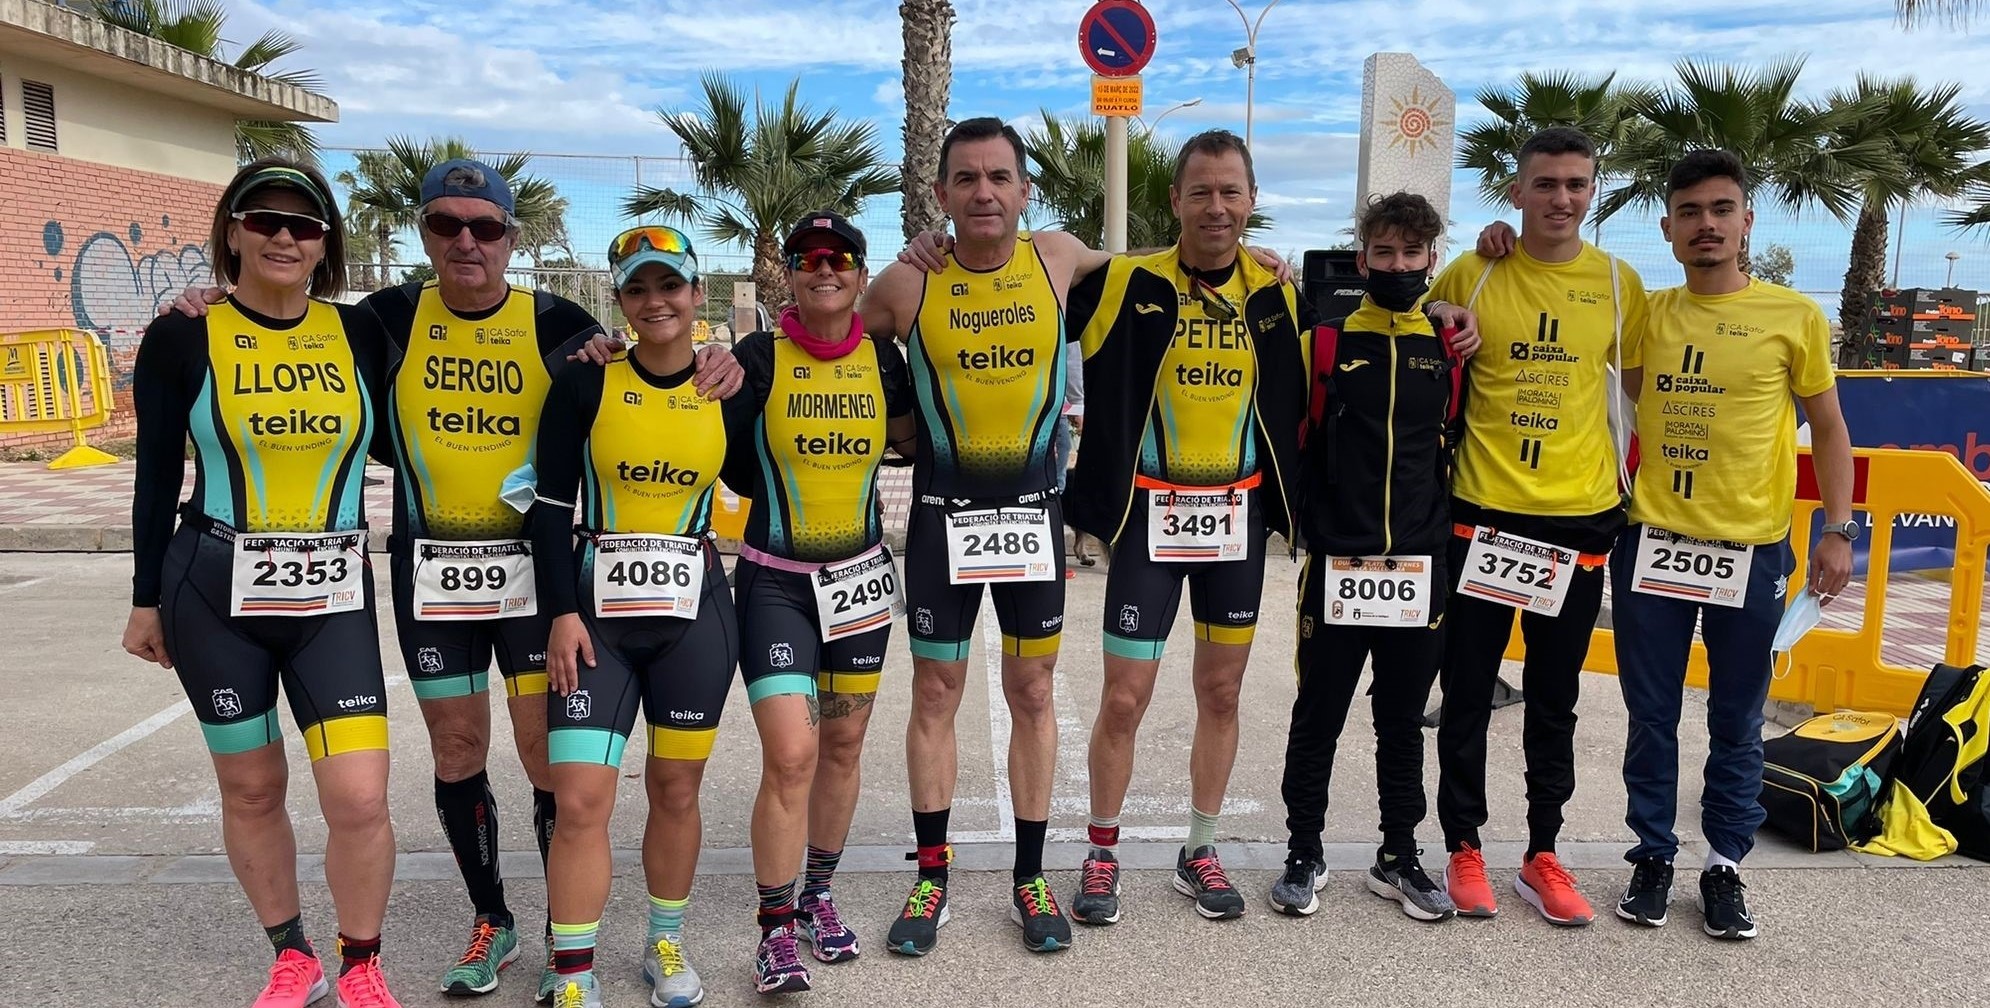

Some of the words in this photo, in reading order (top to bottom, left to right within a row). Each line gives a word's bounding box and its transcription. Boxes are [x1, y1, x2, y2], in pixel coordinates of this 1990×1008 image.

[950, 301, 1036, 334] Nogueroles
[302, 334, 314, 342] CA
[490, 328, 503, 337] CA
[1171, 318, 1248, 350] PETER
[304, 342, 324, 350] teika
[1532, 344, 1564, 353] caixa
[958, 345, 1034, 370] teika
[1531, 352, 1580, 362] popular
[234, 362, 346, 395] LLOPIS
[424, 355, 524, 394] SERGIO
[1176, 361, 1242, 387] teika
[1676, 376, 1708, 386] caixa
[1520, 389, 1558, 399] MORATAL
[1674, 383, 1726, 394] popular
[787, 394, 876, 419] MORMENEO
[249, 409, 342, 436] teika
[427, 406, 520, 436] teika
[1510, 411, 1558, 430] teika
[1667, 421, 1706, 430] MORATAL
[259, 440, 268, 448] EL
[270, 443, 292, 452] BUEN
[295, 438, 332, 452] VENDING
[435, 436, 443, 444] EL
[446, 442, 470, 452] BUEN
[472, 440, 512, 452] VENDING
[794, 432, 870, 455] teika
[1662, 444, 1709, 461] teika
[617, 460, 700, 486] teika
[1202, 496, 1211, 504] DE
[954, 513, 998, 524] FEDERACIÓ
[1012, 512, 1044, 520] TRIATLÓ
[1162, 514, 1231, 536] 3491
[422, 546, 470, 554] FDERACIÓ
[600, 538, 648, 548] FEDERACIÓ
[664, 541, 696, 552] TRIATLÓ
[963, 532, 1040, 556] 2486
[1524, 543, 1536, 552] DE
[861, 561, 870, 570] DE
[1478, 552, 1557, 590] 3752
[1650, 548, 1735, 580] 2505
[252, 558, 348, 587] 2353
[440, 566, 506, 591] 899
[608, 560, 690, 587] 4086
[831, 572, 895, 614] 2490
[1338, 578, 1416, 602] 8006
[1041, 614, 1063, 628] teika
[1228, 610, 1254, 620] teika
[528, 651, 546, 662] tei
[852, 656, 880, 665] teika
[338, 694, 377, 708] teika
[670, 710, 704, 720] teika
